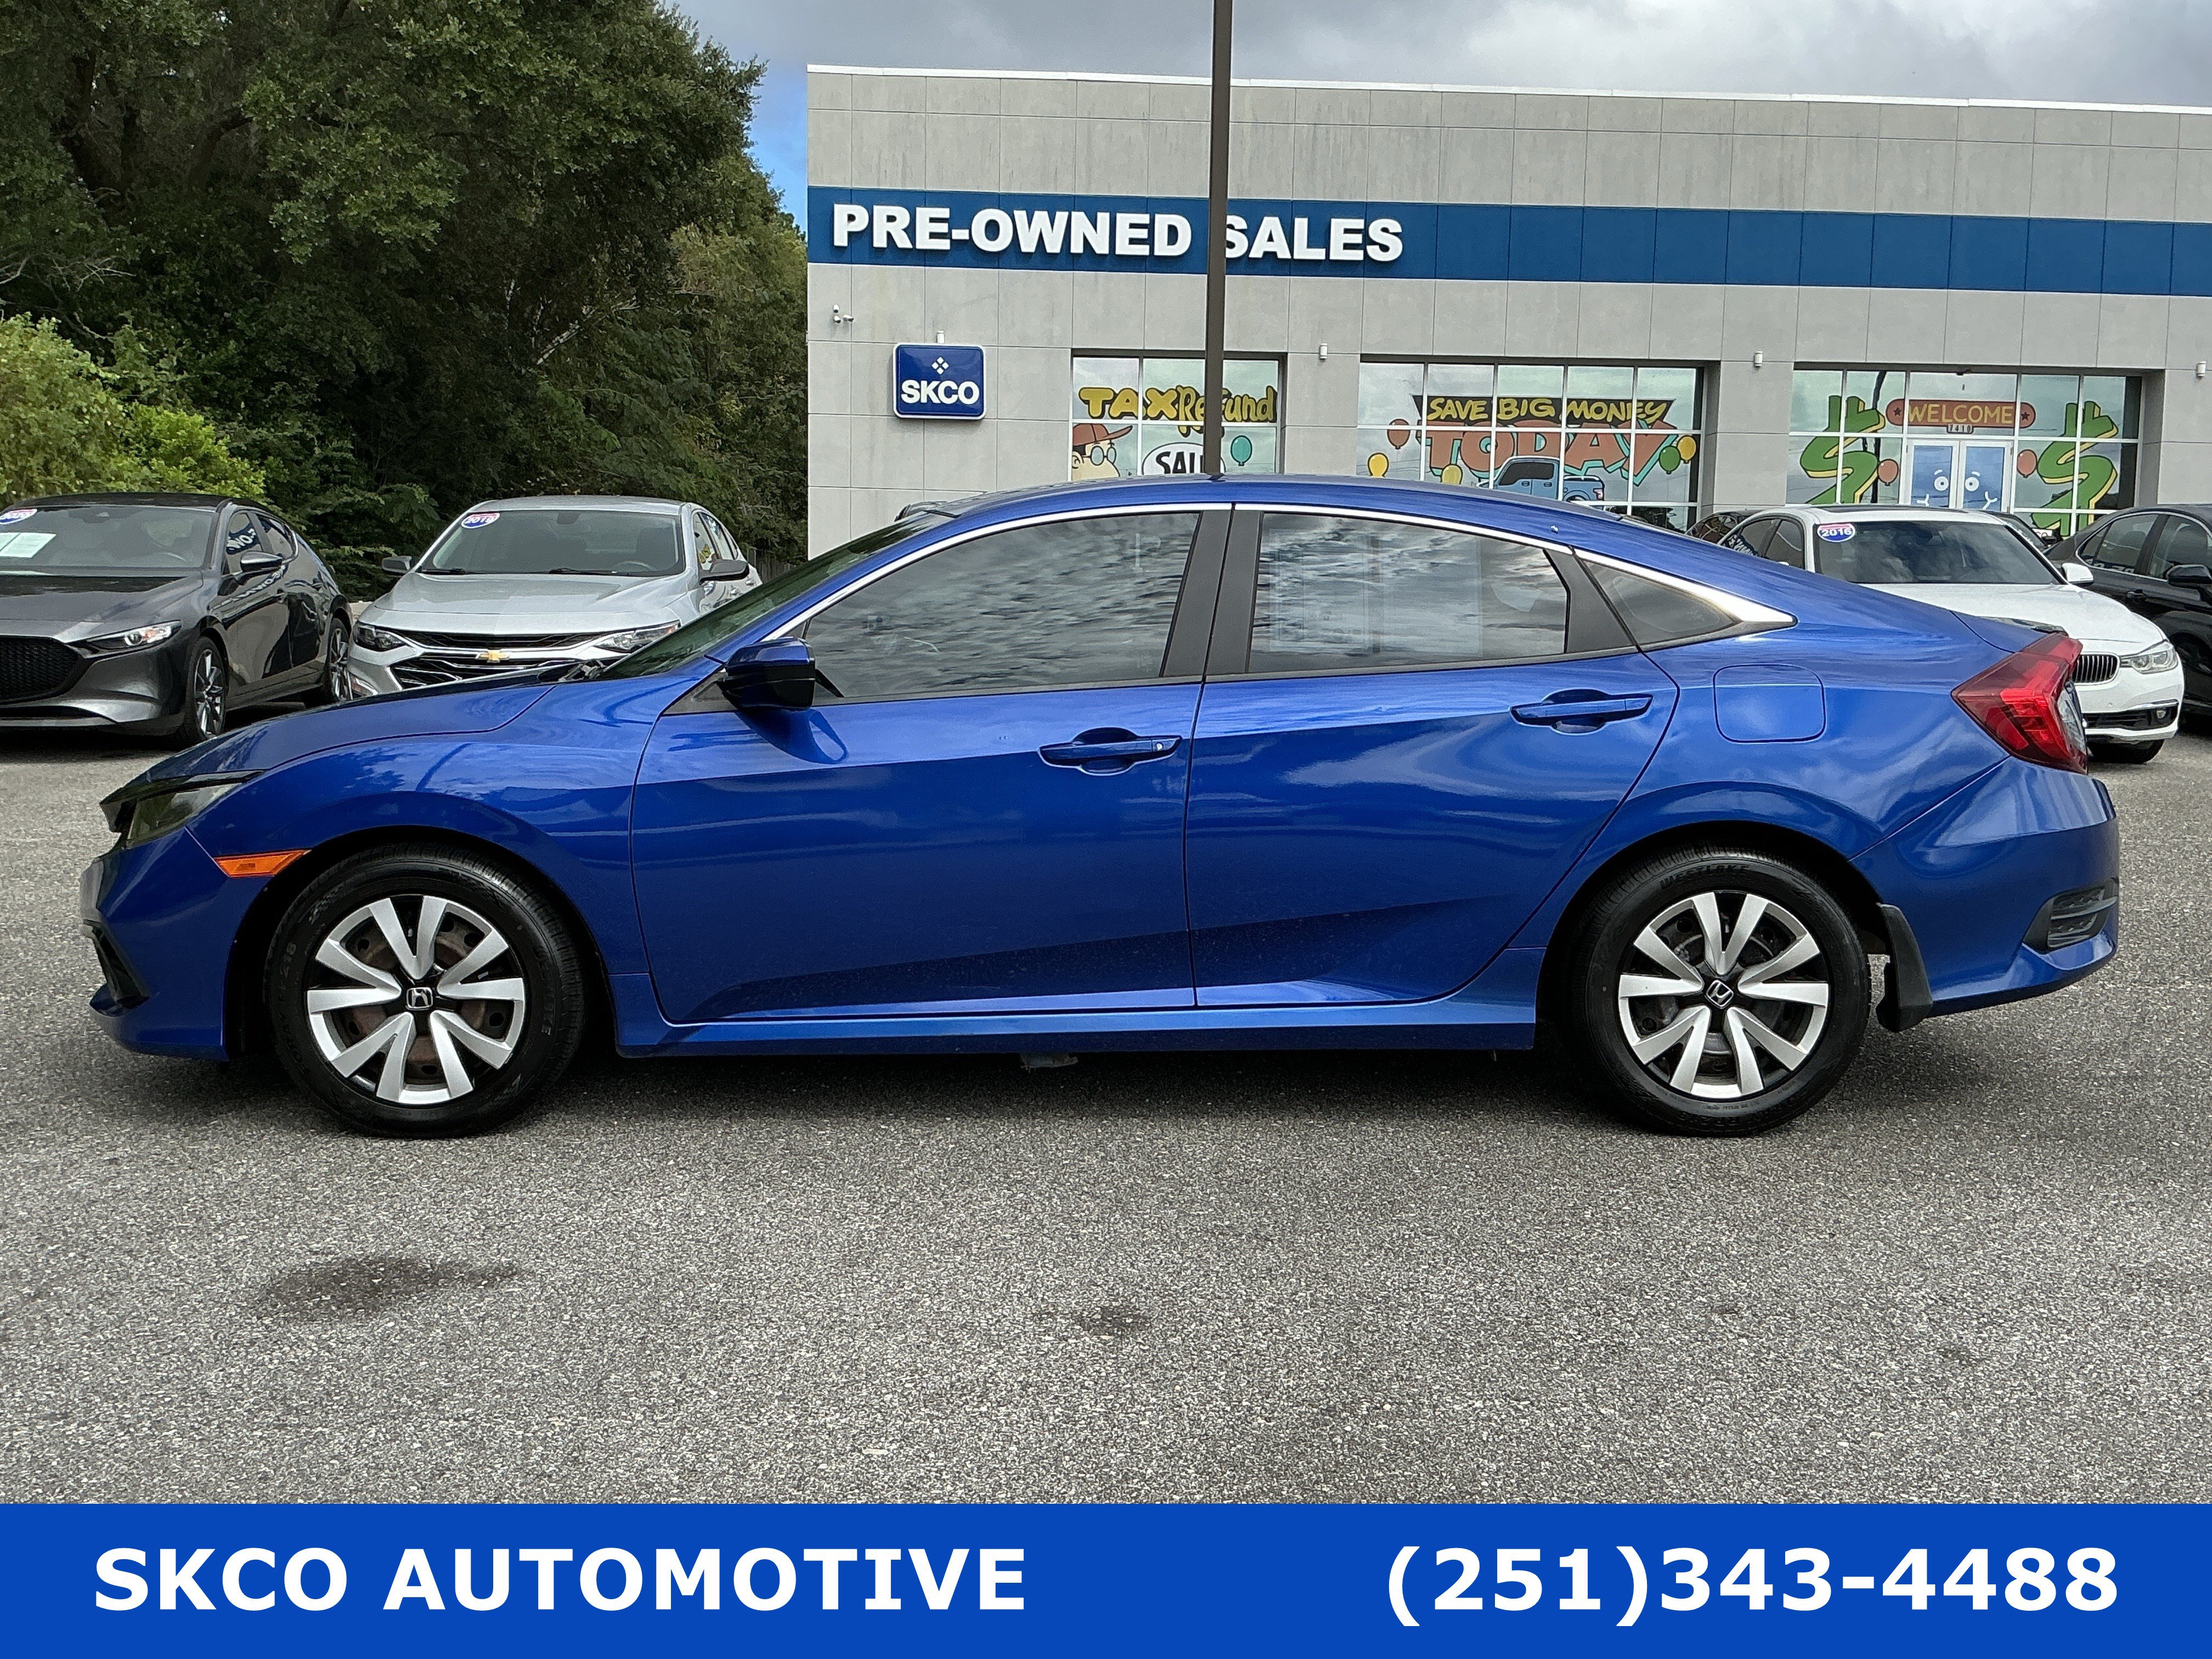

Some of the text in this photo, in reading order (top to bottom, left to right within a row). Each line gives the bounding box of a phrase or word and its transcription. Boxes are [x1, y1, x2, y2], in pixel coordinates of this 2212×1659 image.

[833, 204, 1403, 262] PRE-OWNED SALES
[901, 380, 979, 405] SKCO
[1079, 387, 1178, 420] TAX
[1427, 398, 1667, 424] SAVE BIG MONEY
[1909, 403, 2013, 424] WELCOME
[1949, 424, 1971, 433] 7410
[1155, 451, 1205, 474] SAL
[1416, 420, 1679, 486] TODAY
[1819, 527, 1852, 537] 2016
